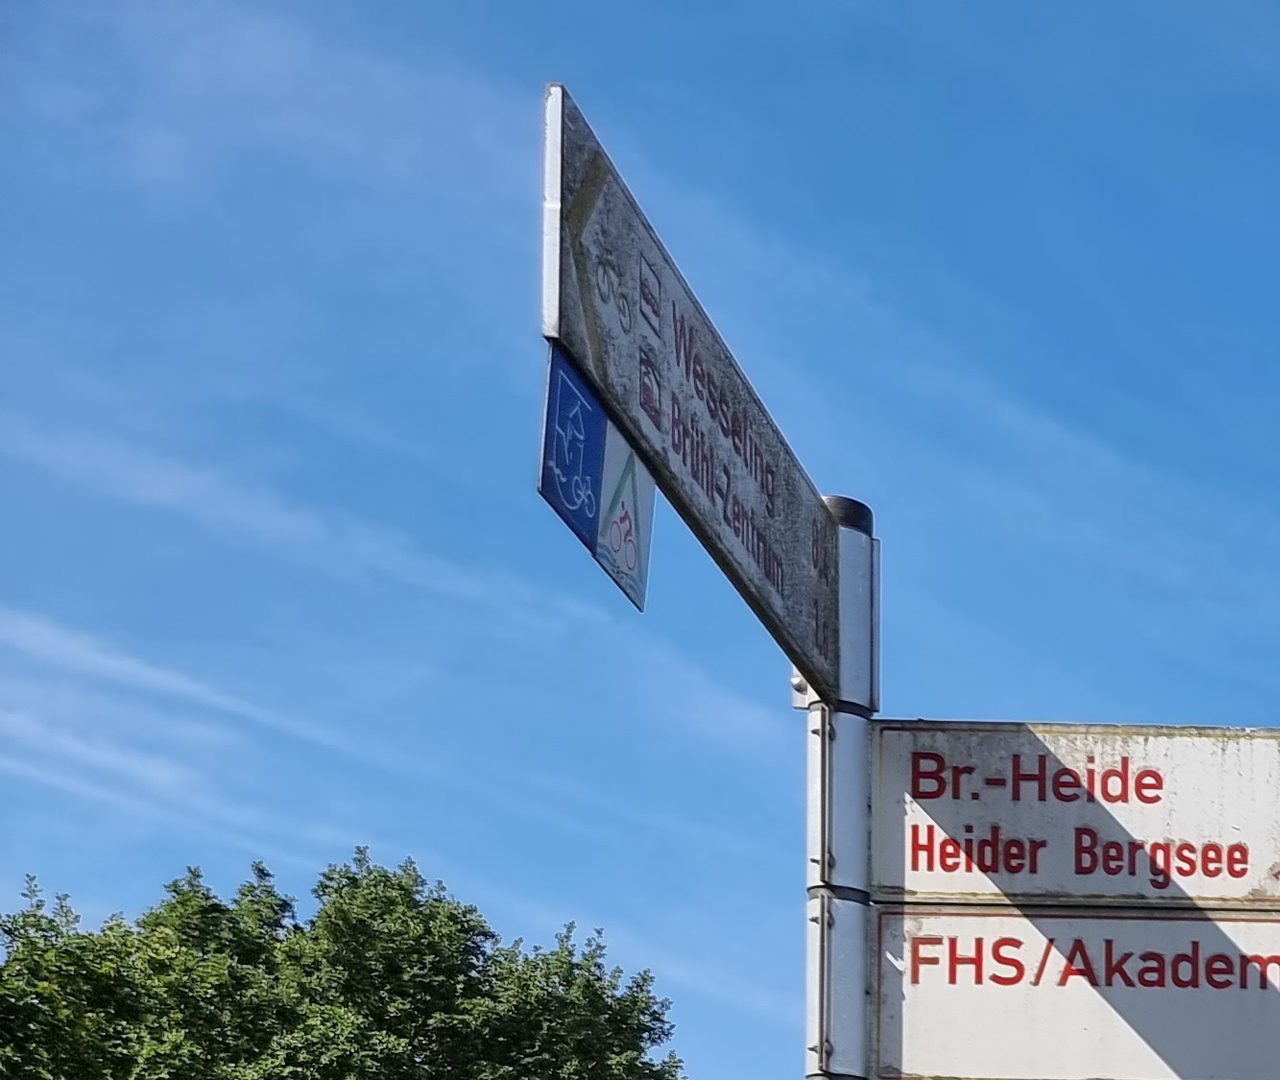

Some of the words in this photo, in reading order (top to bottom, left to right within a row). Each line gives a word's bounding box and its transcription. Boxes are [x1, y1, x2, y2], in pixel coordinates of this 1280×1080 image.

[672, 300, 775, 518] Wesseling
[671, 390, 784, 596] Brühl-Zentrum
[910, 752, 1164, 804] Br.-Heide
[910, 825, 1047, 874] Heider
[1074, 827, 1249, 889] Bergsee
